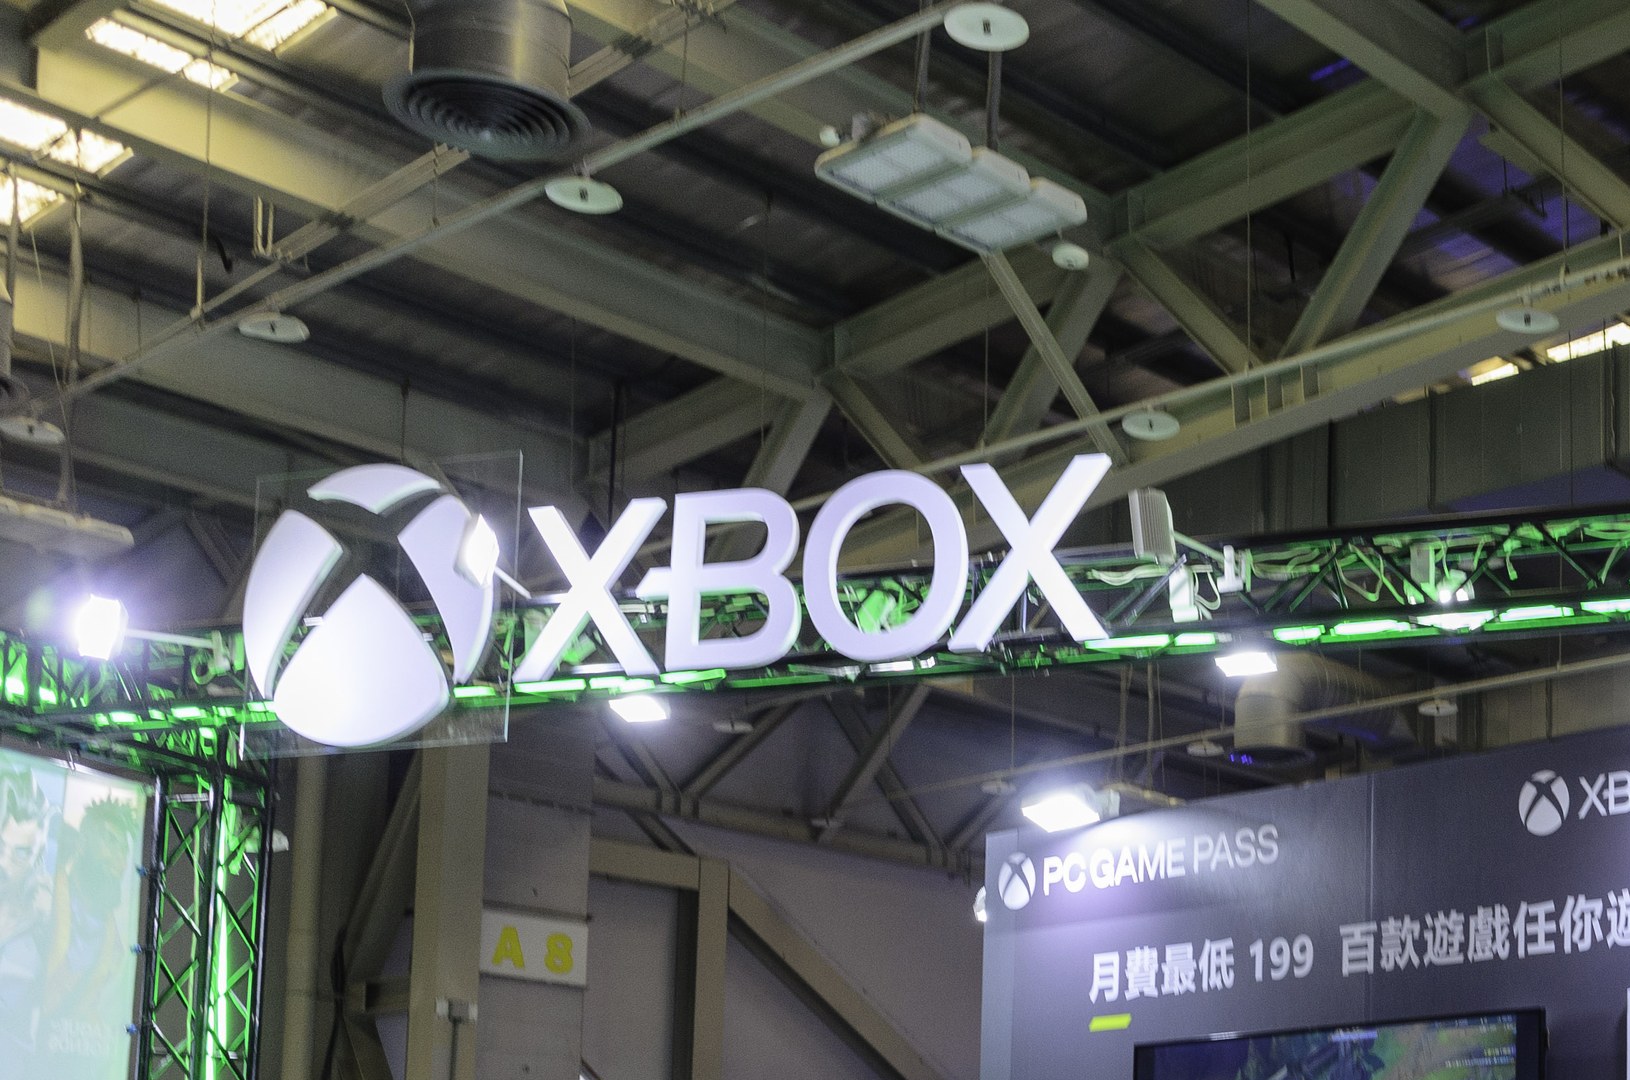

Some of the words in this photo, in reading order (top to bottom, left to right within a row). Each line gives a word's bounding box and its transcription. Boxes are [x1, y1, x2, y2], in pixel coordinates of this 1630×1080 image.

[513, 452, 1112, 682] XBOX
[1043, 851, 1087, 896] PC
[1089, 837, 1187, 889] GAME
[1192, 823, 1279, 875] PASS
[1089, 937, 1235, 1004] 月費最低
[1249, 933, 1315, 982] 199
